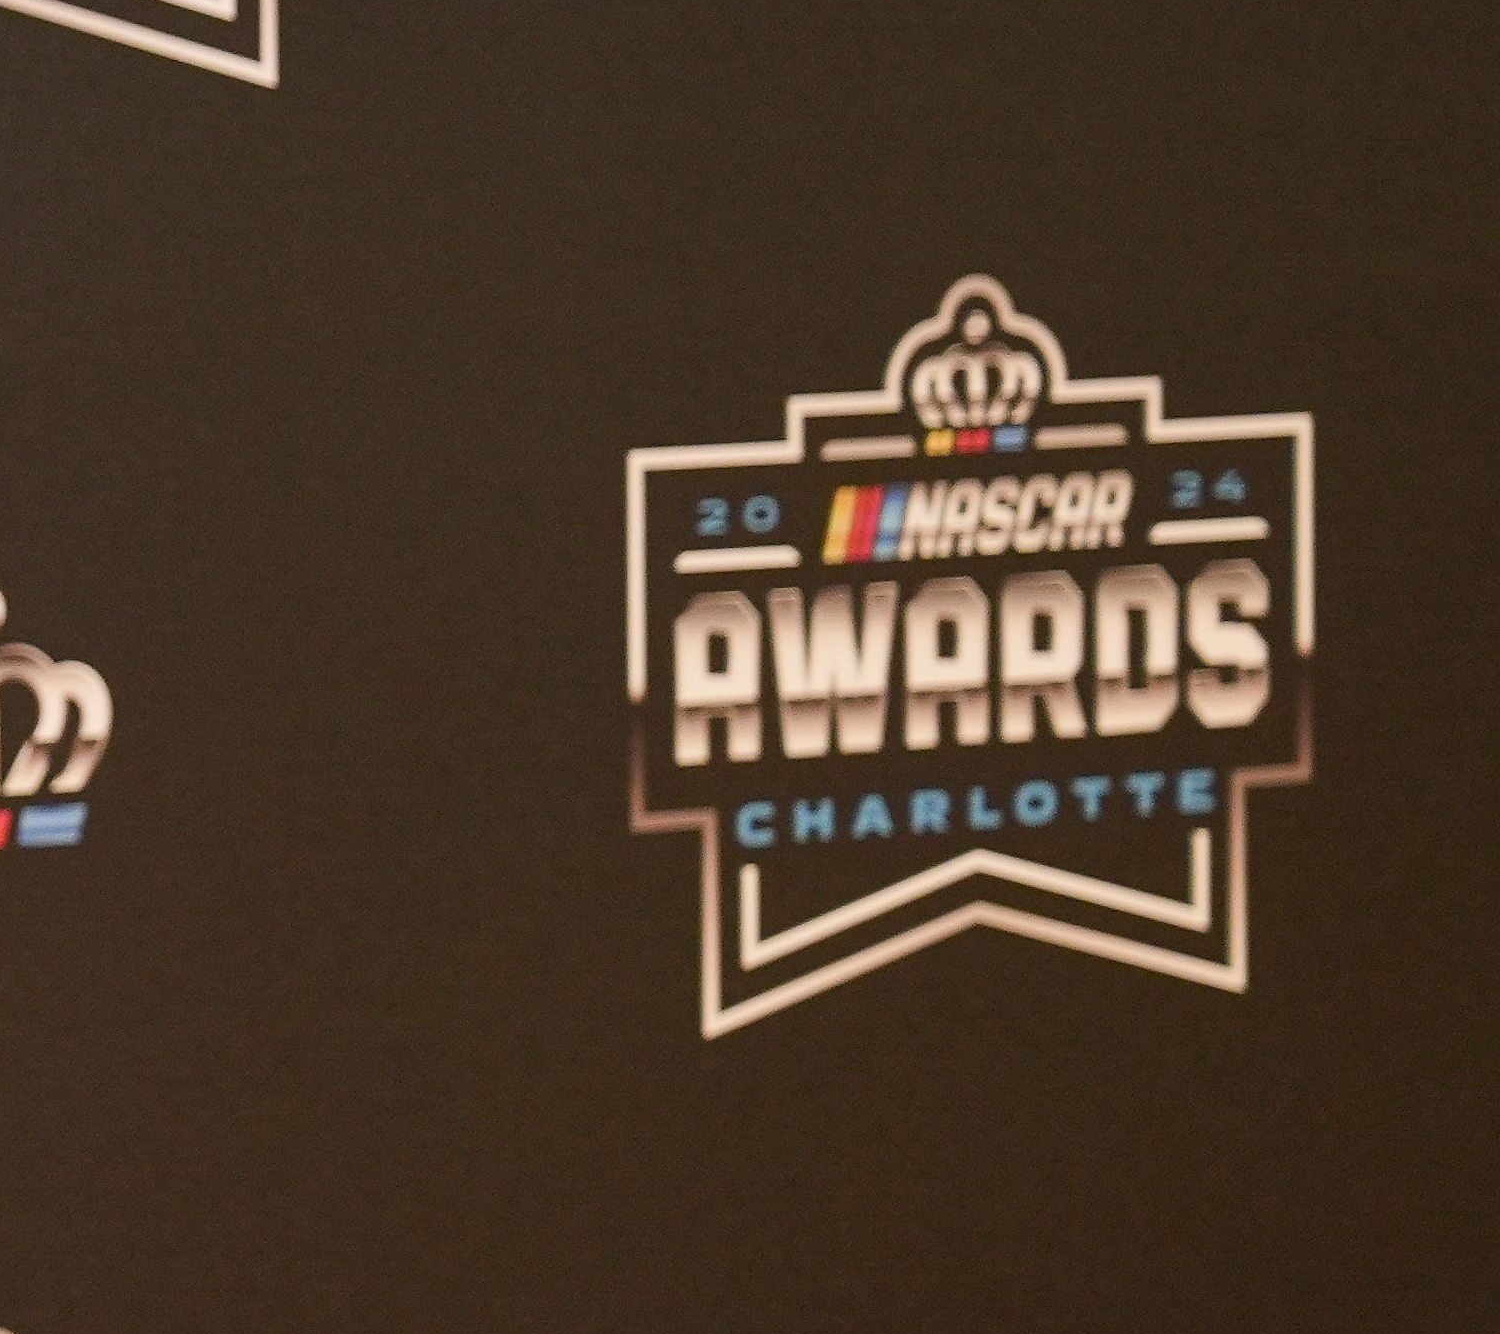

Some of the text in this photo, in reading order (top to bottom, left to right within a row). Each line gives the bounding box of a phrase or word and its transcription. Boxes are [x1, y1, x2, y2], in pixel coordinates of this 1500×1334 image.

[698, 469, 1248, 560] 20 NASCAR 24
[673, 558, 1271, 768] AWARDS
[735, 767, 1218, 849] CHARLOTTE
